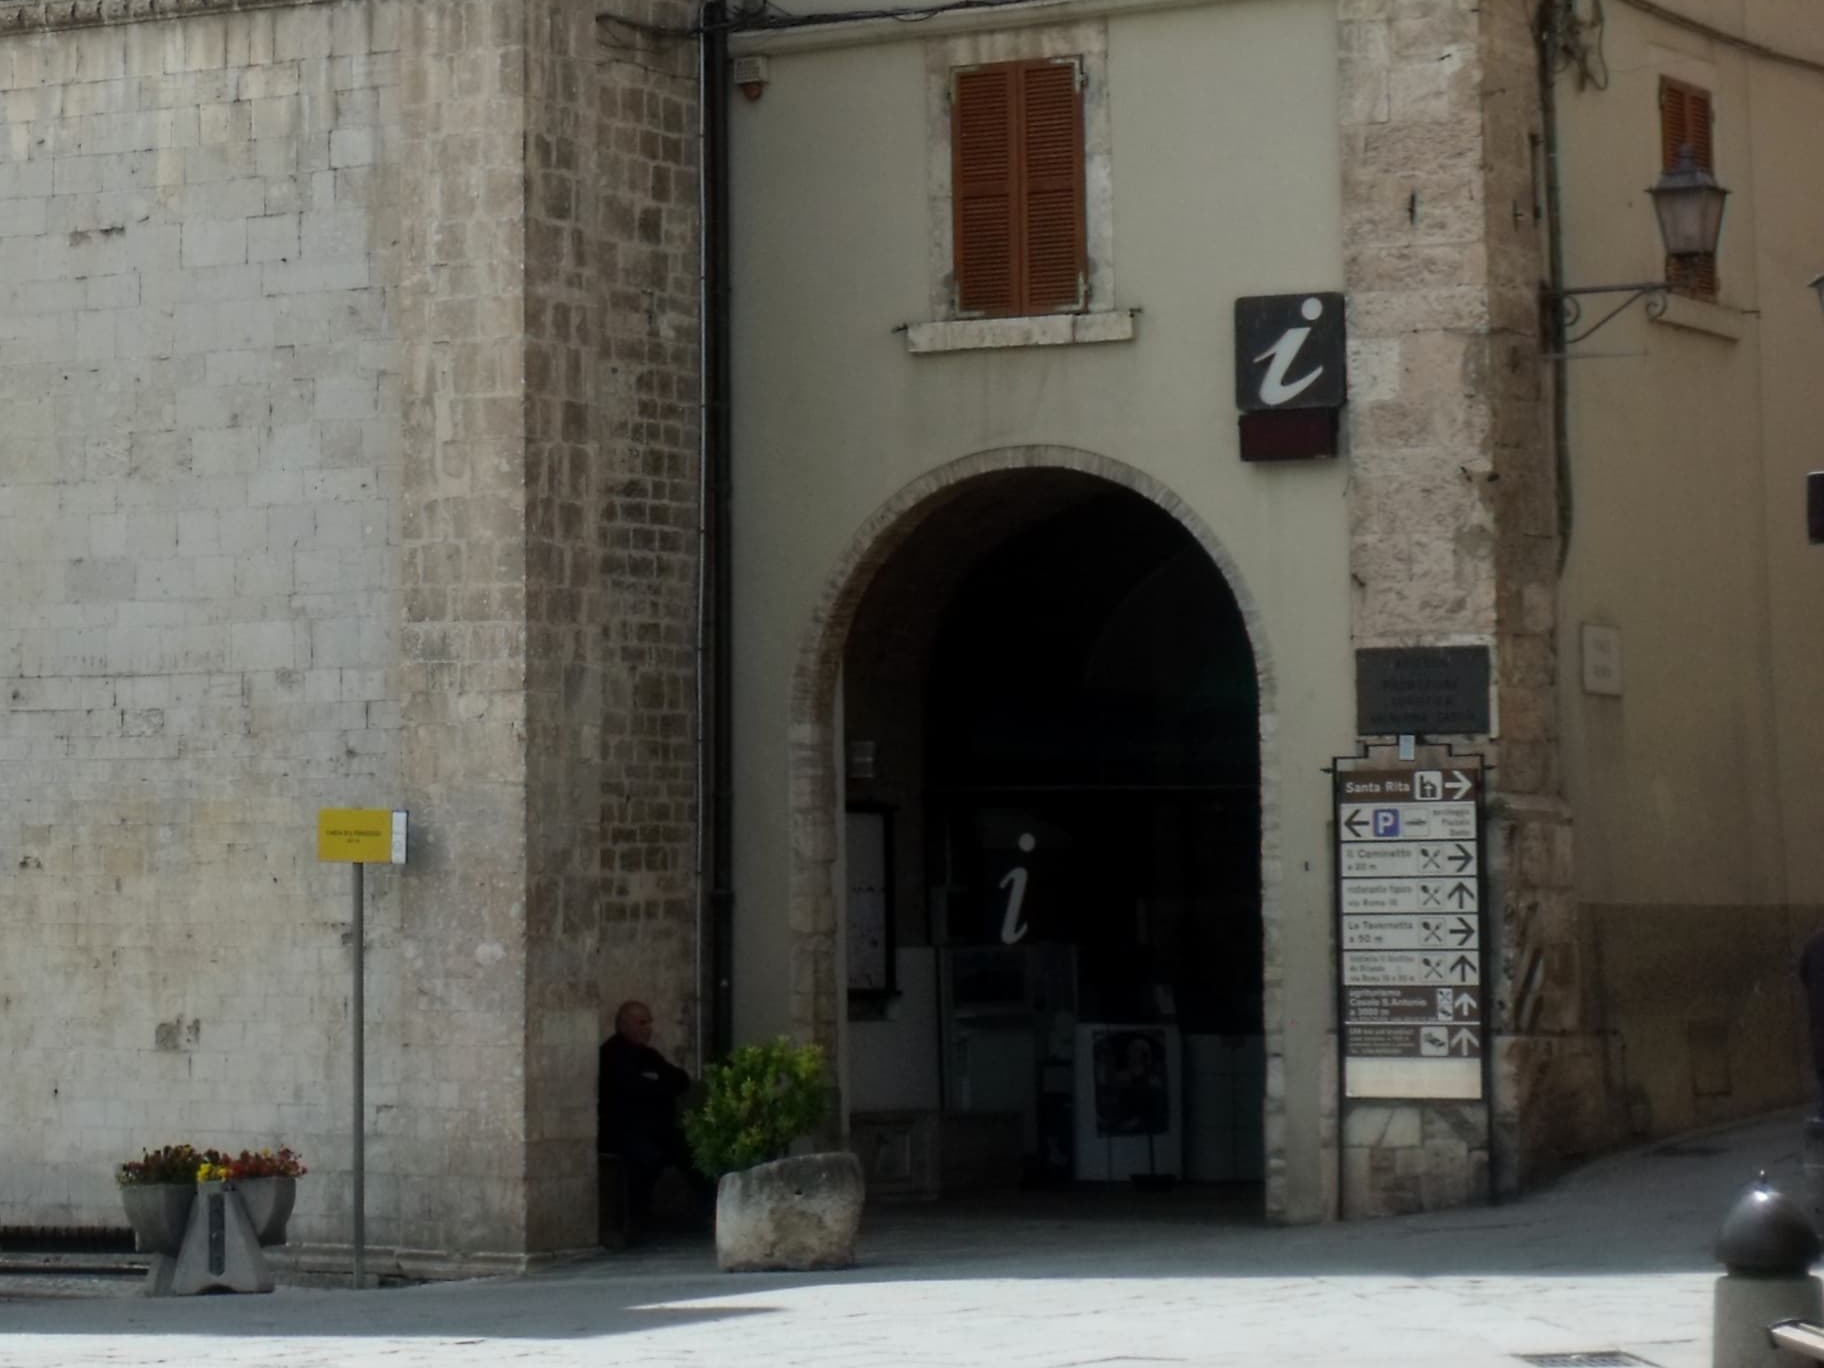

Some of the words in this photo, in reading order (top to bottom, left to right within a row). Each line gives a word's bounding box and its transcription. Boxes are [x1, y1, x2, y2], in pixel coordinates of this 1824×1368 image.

[1253, 297, 1324, 406] i
[1345, 782, 1381, 793] Santa
[1385, 781, 1411, 792] Rita
[1378, 812, 1394, 835] P
[1363, 921, 1413, 930] Tavernetta
